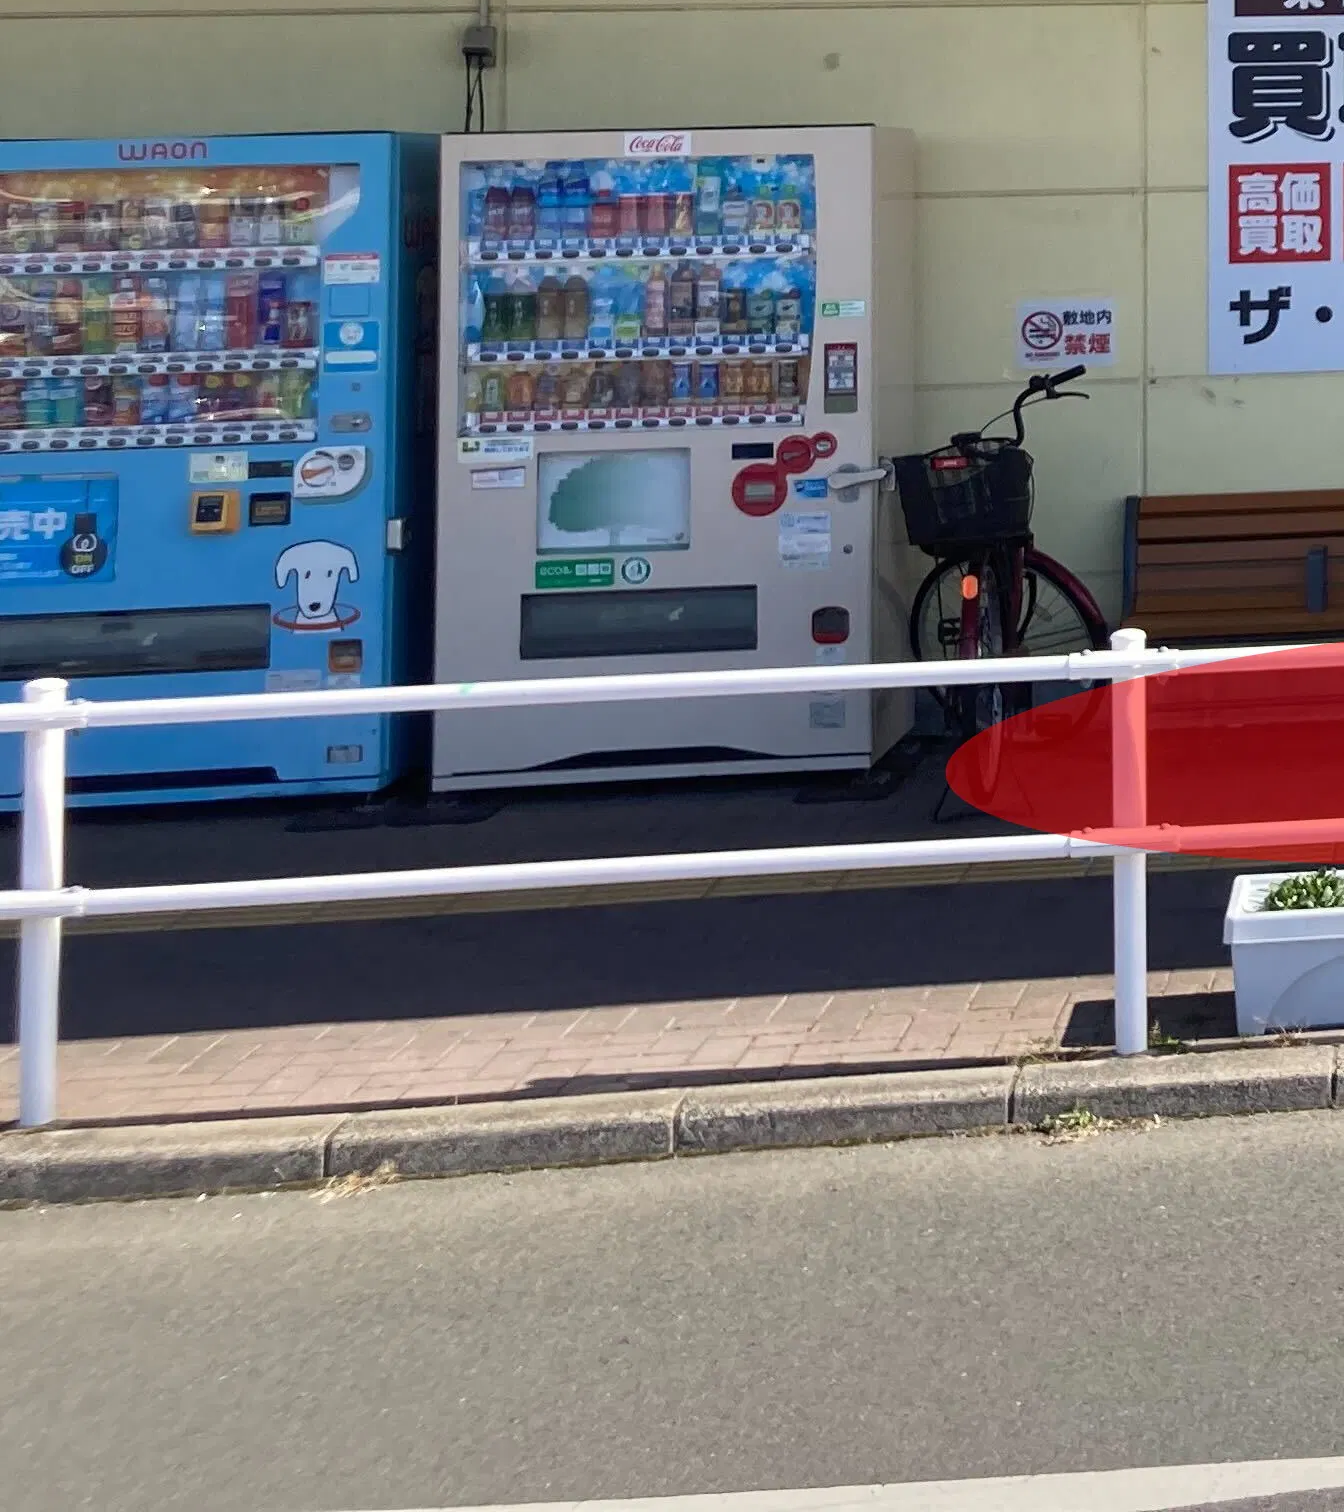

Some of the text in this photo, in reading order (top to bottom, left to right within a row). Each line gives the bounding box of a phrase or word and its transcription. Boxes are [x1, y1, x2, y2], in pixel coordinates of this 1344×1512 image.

[119, 141, 208, 161] WAON
[1237, 171, 1321, 213] 高価
[1237, 213, 1323, 255] 買取
[1062, 309, 1113, 326] 敷地内
[1064, 333, 1111, 356] 禁煙
